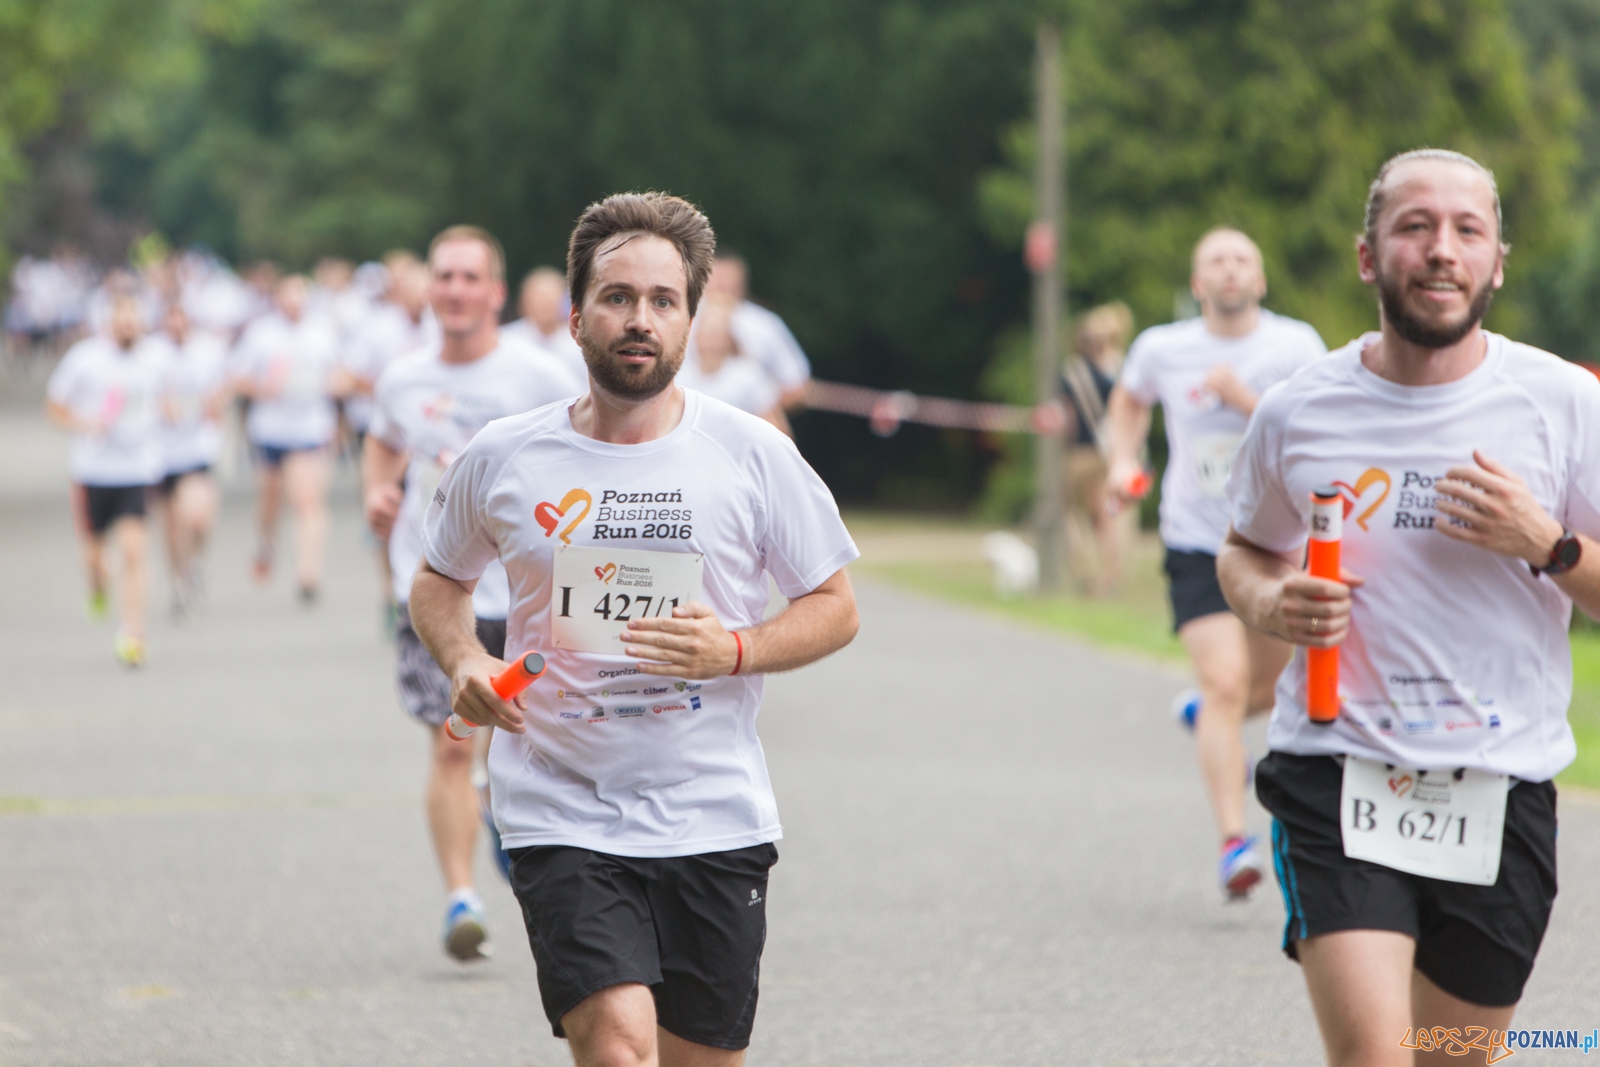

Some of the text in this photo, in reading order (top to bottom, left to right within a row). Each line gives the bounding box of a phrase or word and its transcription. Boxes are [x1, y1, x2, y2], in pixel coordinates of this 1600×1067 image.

[601, 489, 682, 504] Poznań
[596, 506, 692, 521] Business
[593, 524, 692, 539] Run 2016
[594, 592, 680, 621] 427/1
[599, 668, 641, 678] Organizat
[643, 687, 669, 695] ciber
[1352, 799, 1377, 831] B
[1398, 810, 1467, 845] 62/1
